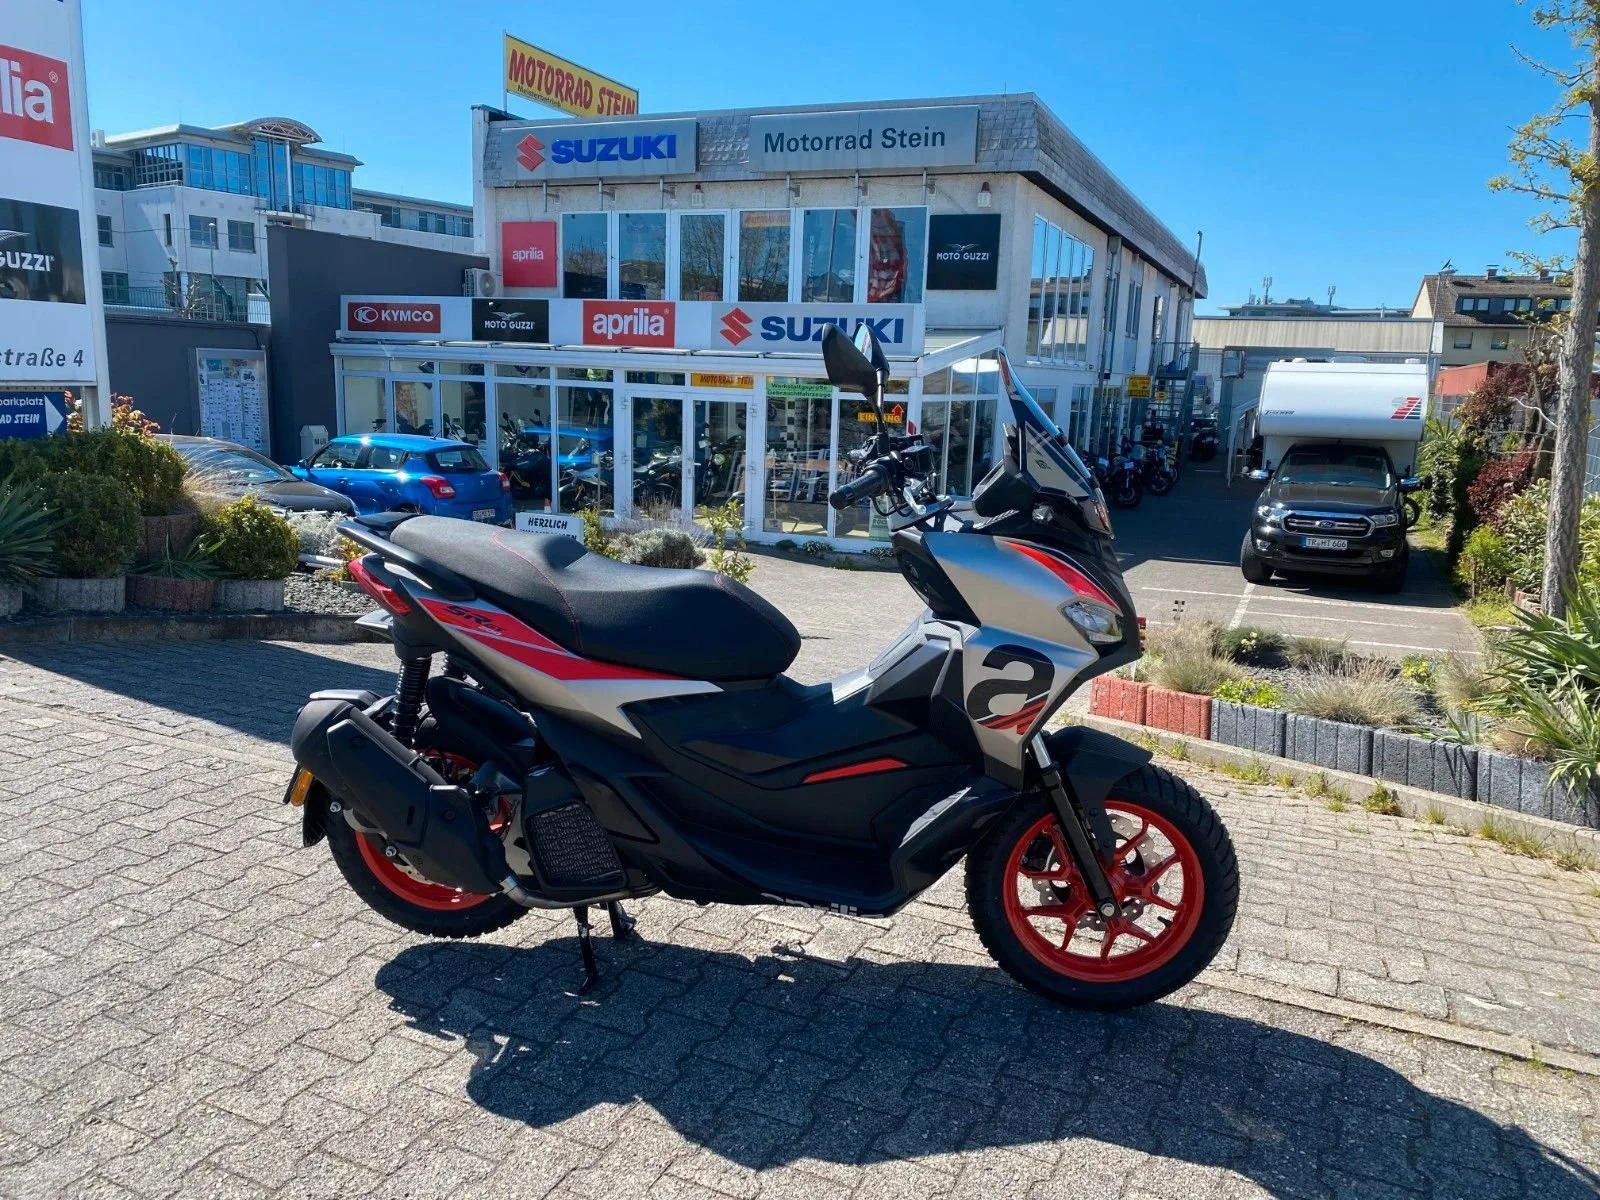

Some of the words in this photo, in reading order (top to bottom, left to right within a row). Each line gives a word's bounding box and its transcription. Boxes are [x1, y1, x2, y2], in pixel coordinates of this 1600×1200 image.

[509, 48, 593, 110] MOTORRAD
[597, 86, 636, 117] STEIN
[764, 128, 873, 153] Motorrad
[881, 126, 946, 149] Stein
[551, 134, 677, 165] SUZUKI
[512, 246, 544, 262] aprilia
[936, 252, 960, 261] MOTO
[962, 252, 989, 261] GUZZI
[381, 310, 434, 323] KYMCO
[592, 307, 665, 340] aprilia
[484, 320, 507, 330] MOTO
[509, 321, 534, 331] GUZZI
[0, 347, 66, 367] traße
[73, 349, 84, 367] 4
[13, 413, 40, 424] STEIN
[527, 517, 568, 530] HERZLICH
